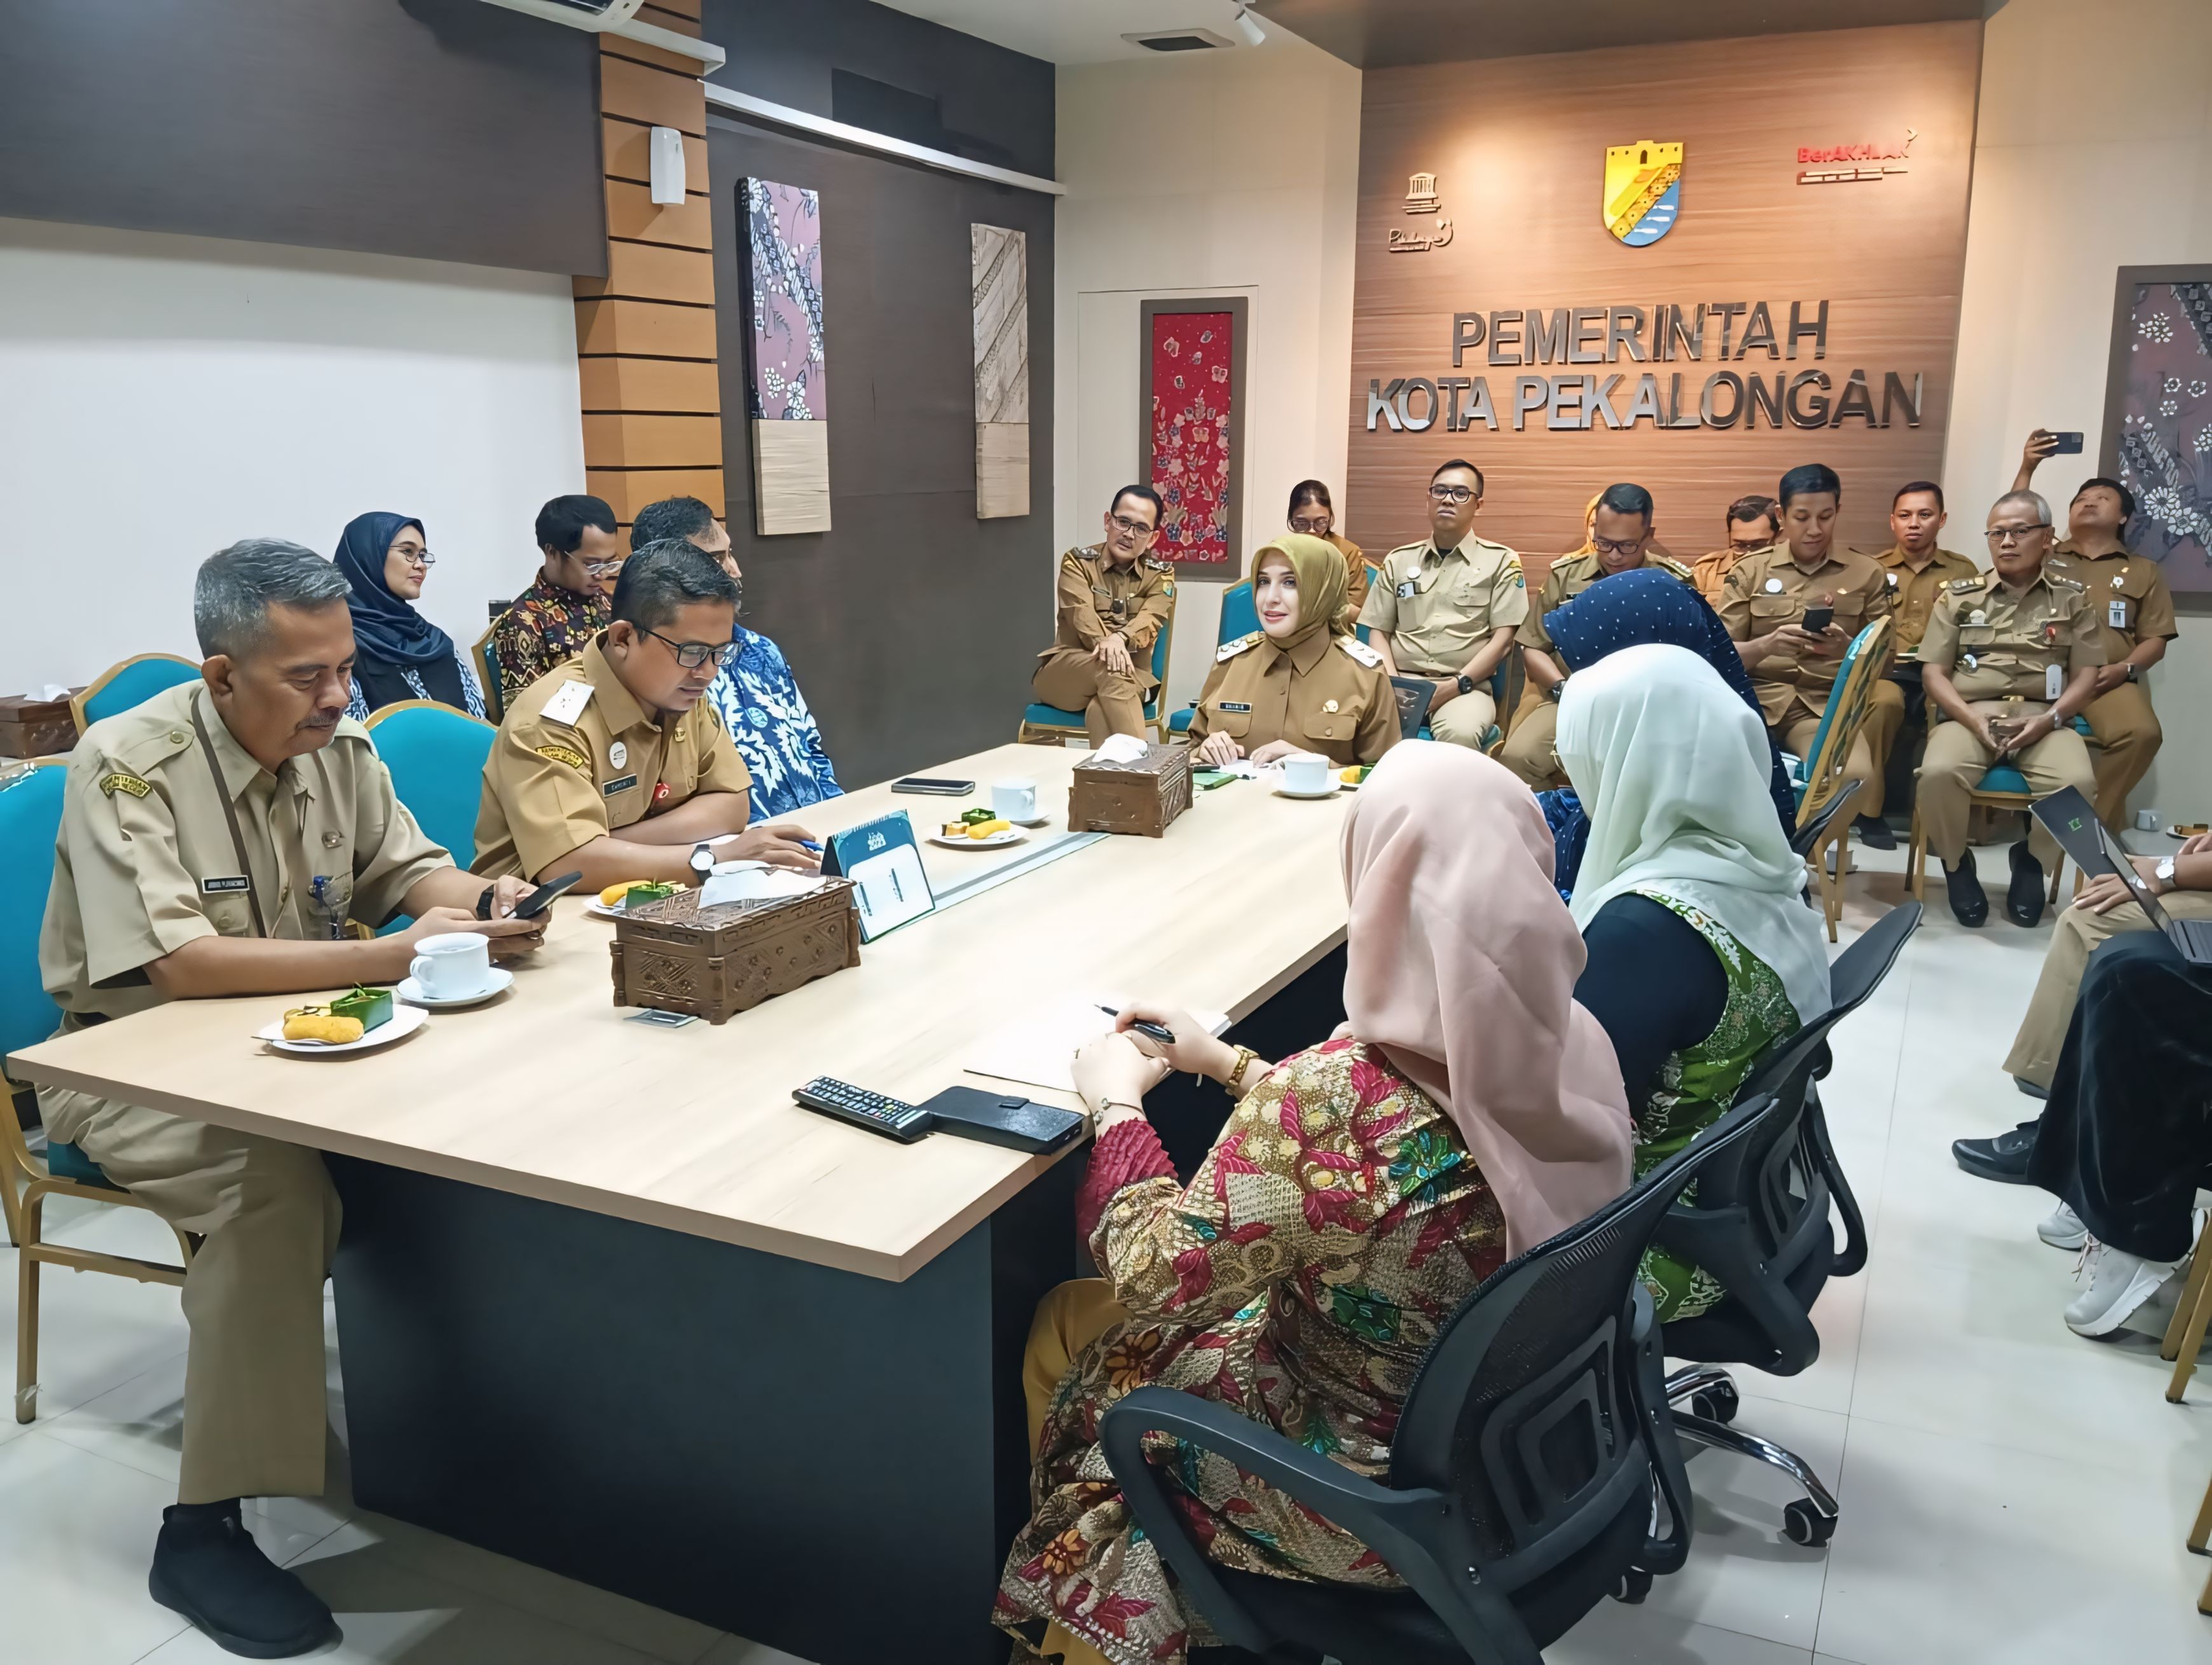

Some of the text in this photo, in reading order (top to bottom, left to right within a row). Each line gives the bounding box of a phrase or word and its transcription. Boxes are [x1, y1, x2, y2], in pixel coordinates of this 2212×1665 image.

[1452, 300, 1829, 367] PEMERINTAH
[1367, 368, 1923, 432] KOTA PEKALONGAN
